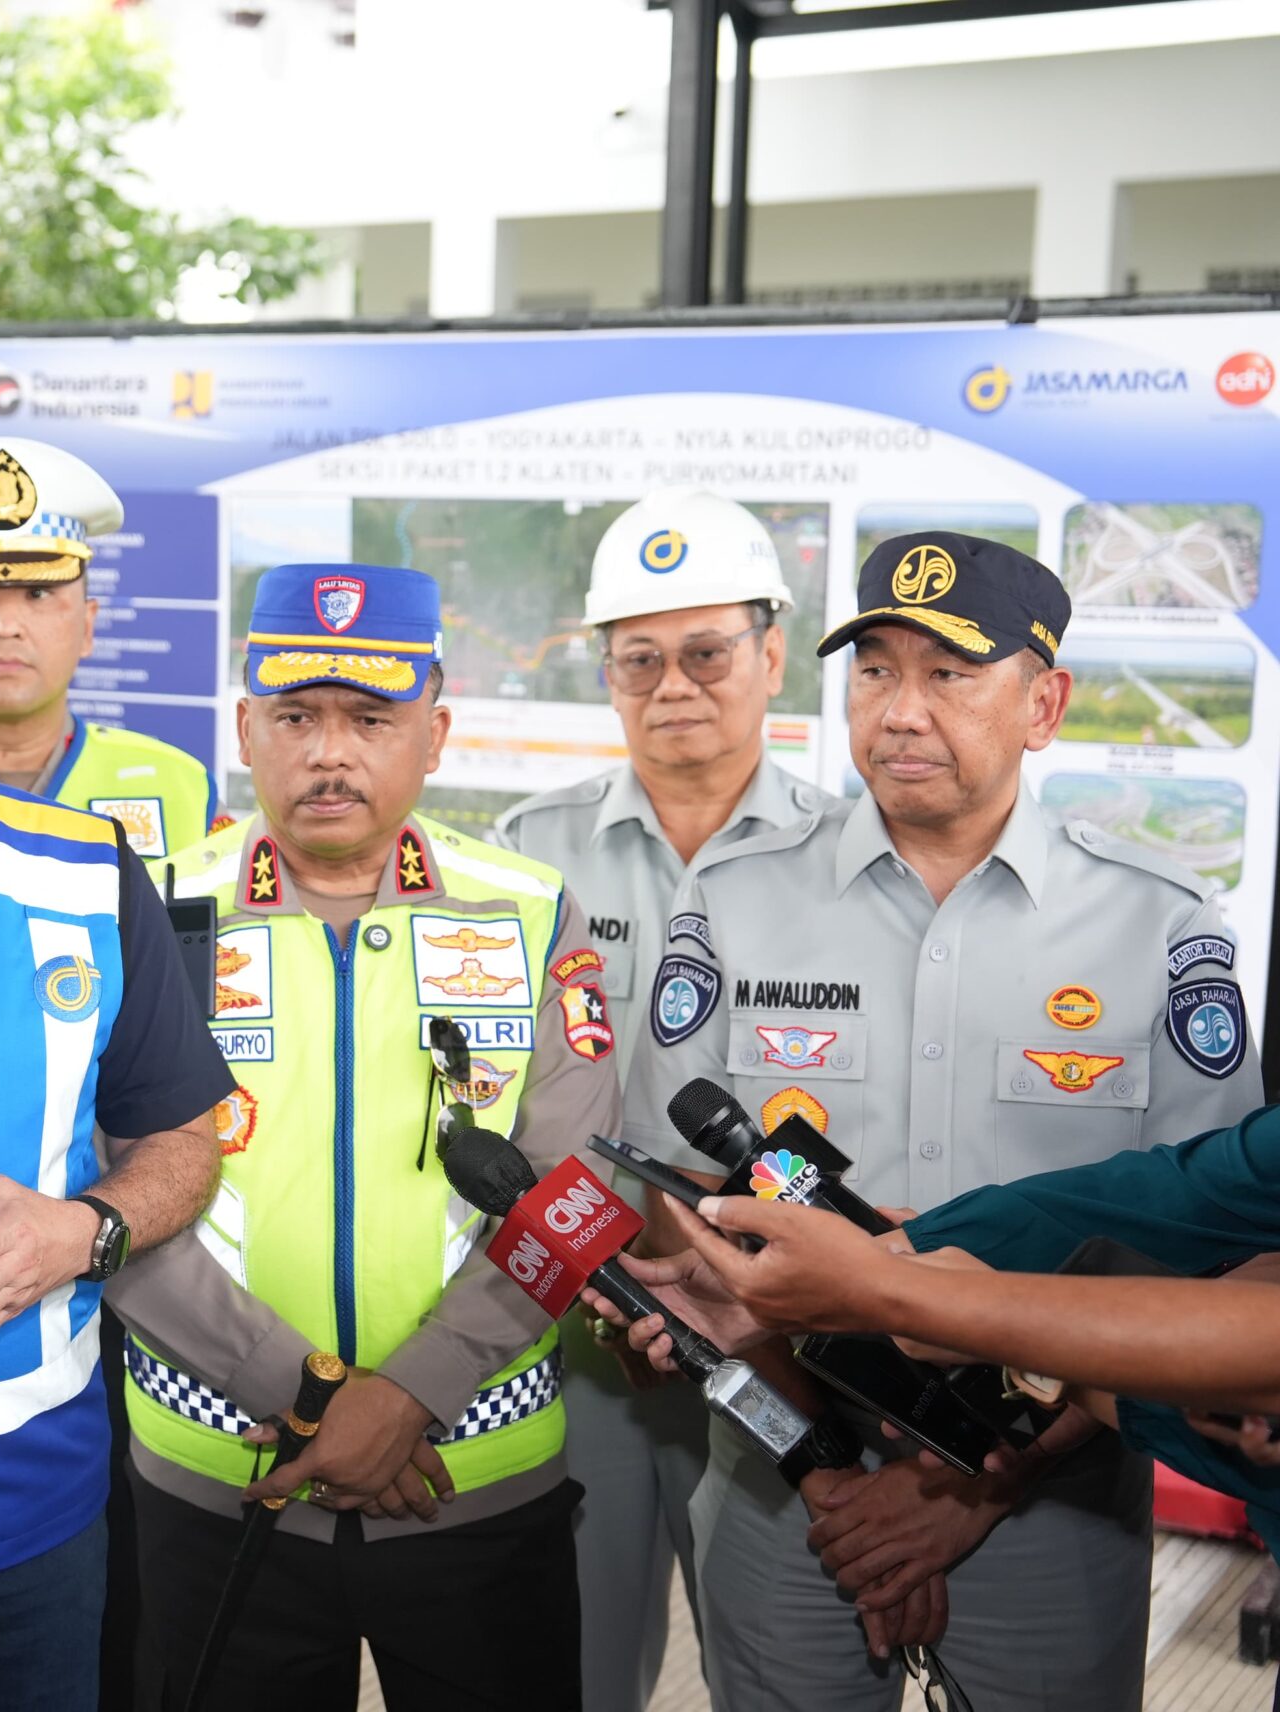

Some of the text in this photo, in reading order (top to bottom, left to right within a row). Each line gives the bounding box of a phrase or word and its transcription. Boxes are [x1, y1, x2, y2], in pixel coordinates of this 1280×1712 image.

[31, 371, 148, 393] Danantara
[1023, 368, 1189, 394] JASAMARGA
[31, 401, 141, 418] Indonesia
[484, 427, 644, 449] YOGYAKARTA
[742, 426, 933, 451] KULONPROGO
[401, 460, 476, 483] PAKET
[517, 460, 613, 482] KLATEN
[642, 461, 859, 485] PURWOMARTANI
[1169, 943, 1229, 970] KANTOR PUSAT
[662, 963, 714, 992] JASA RAHARJA
[735, 979, 860, 1010] M AWALUDDIN
[1174, 989, 1237, 1011] JASA RAHARJA
[215, 1034, 266, 1056] SURYO
[453, 1021, 524, 1044] OLRI
[773, 1163, 819, 1202] NBC
[789, 1175, 821, 1204] ONESIA
[544, 1176, 607, 1234] CNN
[567, 1205, 620, 1252] Indonesia
[507, 1230, 551, 1284] CNN
[531, 1259, 565, 1300] Indonesia
